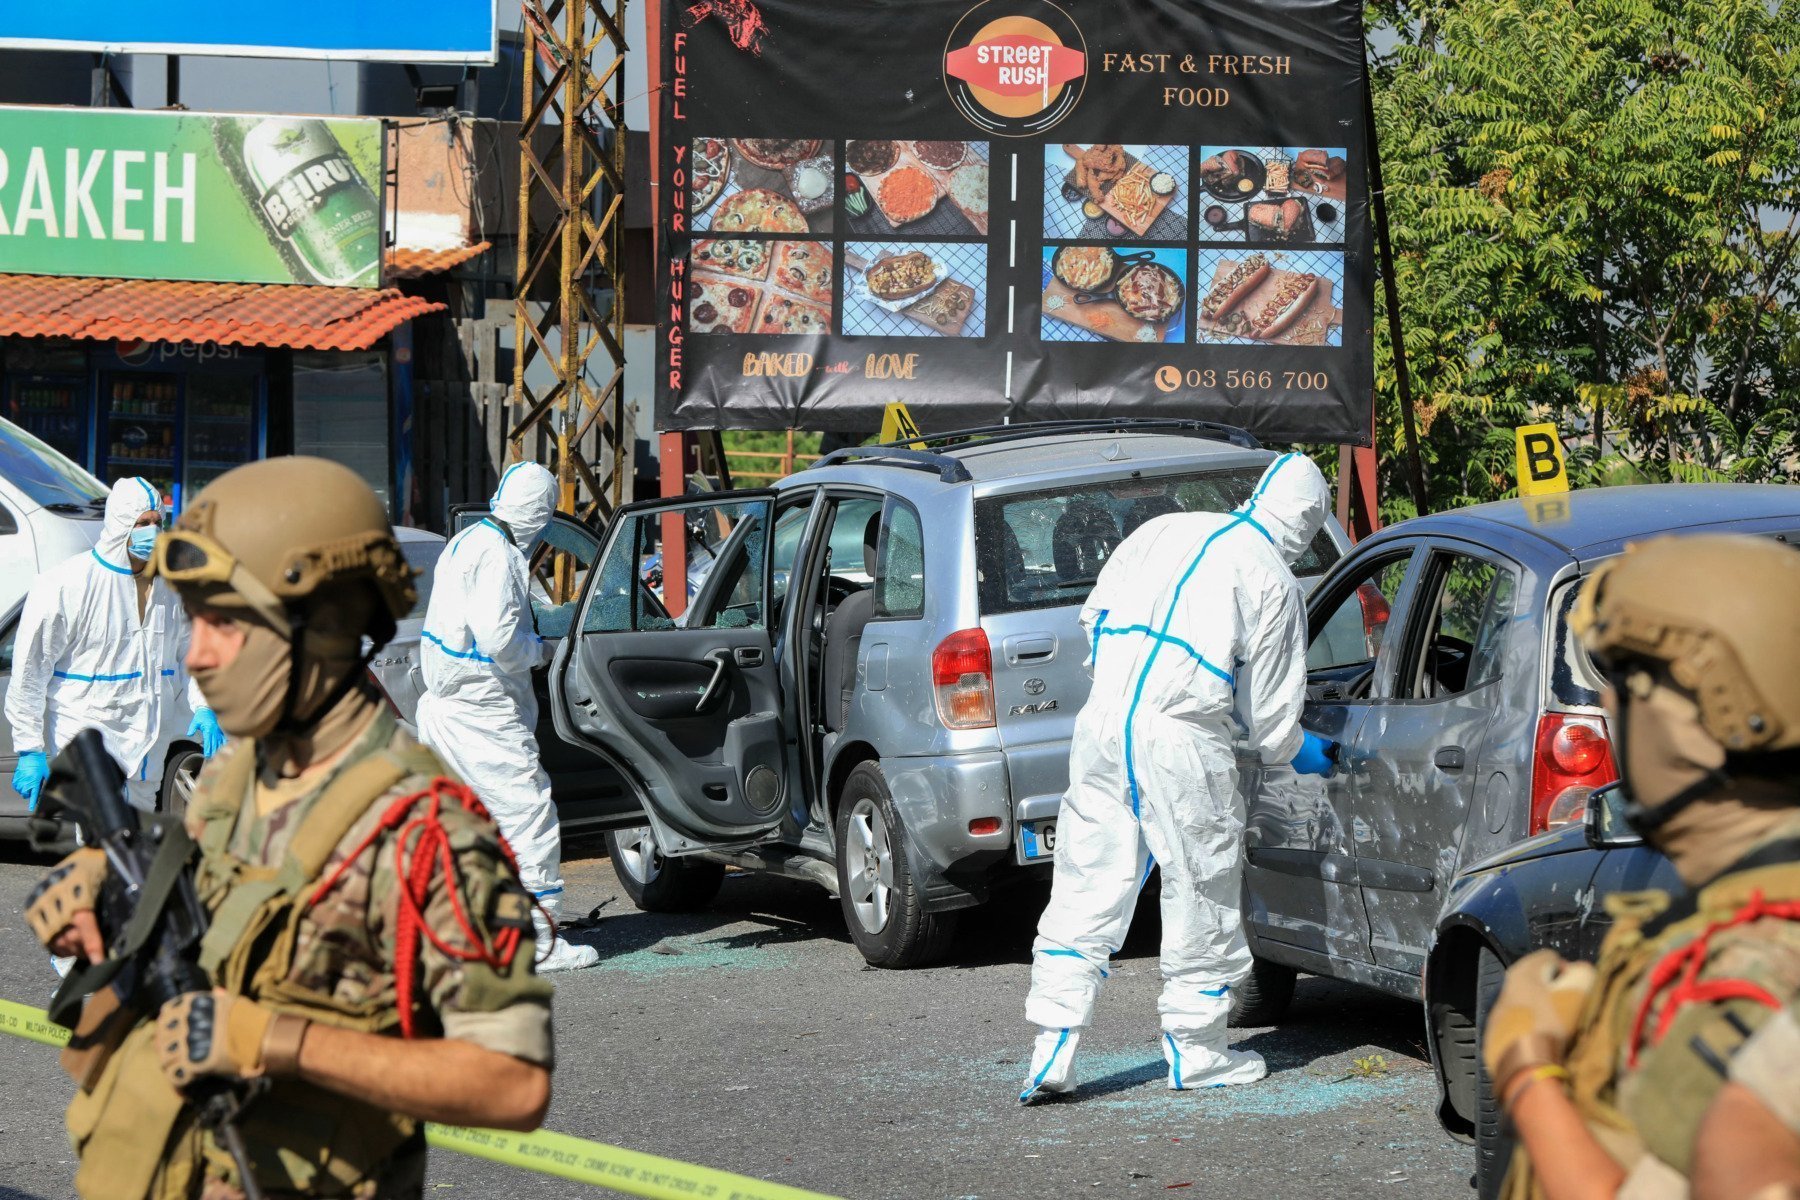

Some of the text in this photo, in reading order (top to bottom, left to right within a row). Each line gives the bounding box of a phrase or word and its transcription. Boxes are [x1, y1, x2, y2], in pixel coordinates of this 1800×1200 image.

[998, 66, 1049, 85] RUSH
[1102, 53, 1292, 76] FAST & FRESH
[1163, 87, 1230, 107] FOOD
[668, 33, 688, 390] FUEL YOUR HUNGER
[742, 351, 814, 378] BAKED
[864, 353, 920, 380] LOVE
[1186, 368, 1328, 390] 03 566 700
[896, 409, 919, 439] A
[1523, 433, 1561, 481] B
[1008, 699, 1059, 716] RAV4
